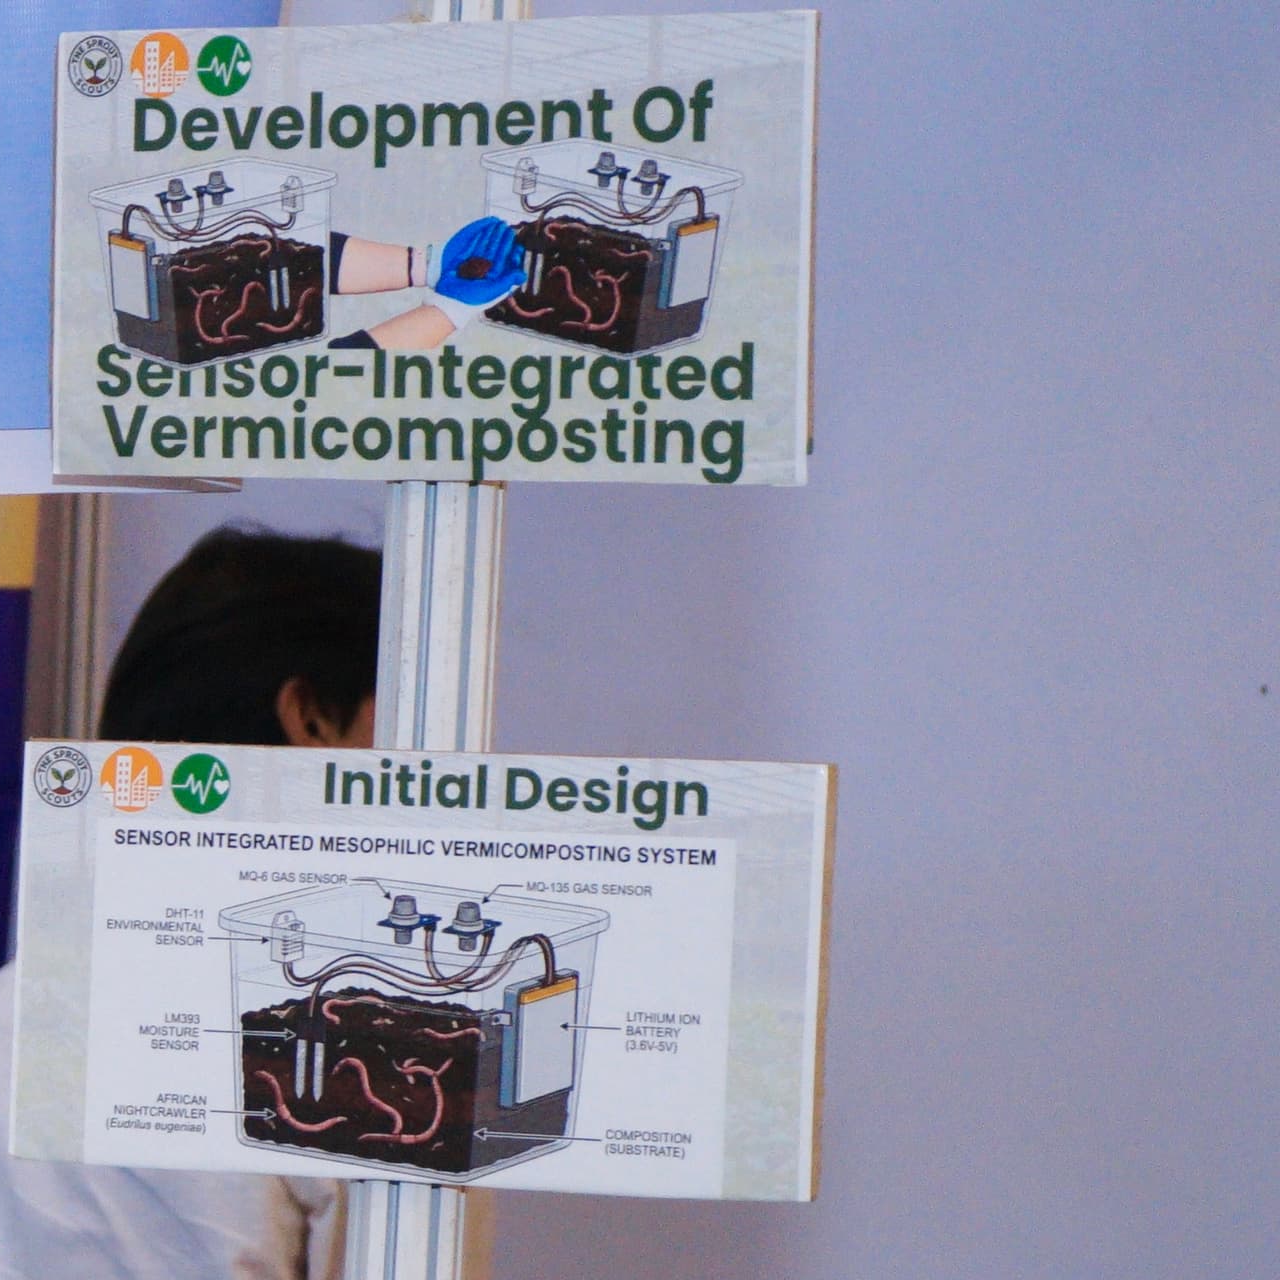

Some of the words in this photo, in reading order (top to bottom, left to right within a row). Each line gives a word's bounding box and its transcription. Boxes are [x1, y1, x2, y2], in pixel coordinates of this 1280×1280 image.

[71, 44, 88, 63] THE
[87, 38, 120, 60] SPROUT
[76, 77, 116, 93] SCOUTS
[133, 87, 613, 168] Development
[632, 78, 715, 144] Of
[97, 341, 755, 420] Sensor-Integrated
[102, 401, 746, 485] Vermicomposting
[53, 750, 89, 771] SPROUT
[41, 788, 83, 804] SCOUTS
[323, 760, 488, 811] Initial
[506, 768, 709, 830] Design
[114, 829, 191, 847] SENSOR
[196, 831, 315, 852] INTEGRATED
[320, 836, 435, 857] MESOPHILIC
[441, 840, 631, 863] VERMICOMPOSTING
[637, 846, 717, 866] SYSTEM
[238, 870, 268, 882] MQ-6
[271, 871, 296, 882] GAS
[298, 873, 348, 885] SENSOR
[526, 881, 570, 893] MQ-135
[572, 882, 598, 894] GAS
[601, 884, 653, 897] SENSOR
[165, 907, 205, 919] DHT-11
[106, 918, 205, 933] ENVIRONMENTAL
[155, 934, 204, 946] SENSOR
[164, 1012, 201, 1024] LM393
[626, 1011, 675, 1024] LITHIUM
[679, 1013, 701, 1025] ION
[138, 1024, 200, 1037] MOISTURE
[626, 1025, 682, 1038] BATTERY
[150, 1038, 199, 1051] SENSOR
[625, 1038, 679, 1054] (3.6V-5V)
[156, 1093, 208, 1105] AFRICAN
[113, 1104, 207, 1119] NIGHTCRAWLER
[605, 1128, 692, 1144] COMPOSITION
[604, 1142, 687, 1160] (SUBSTRATE)
